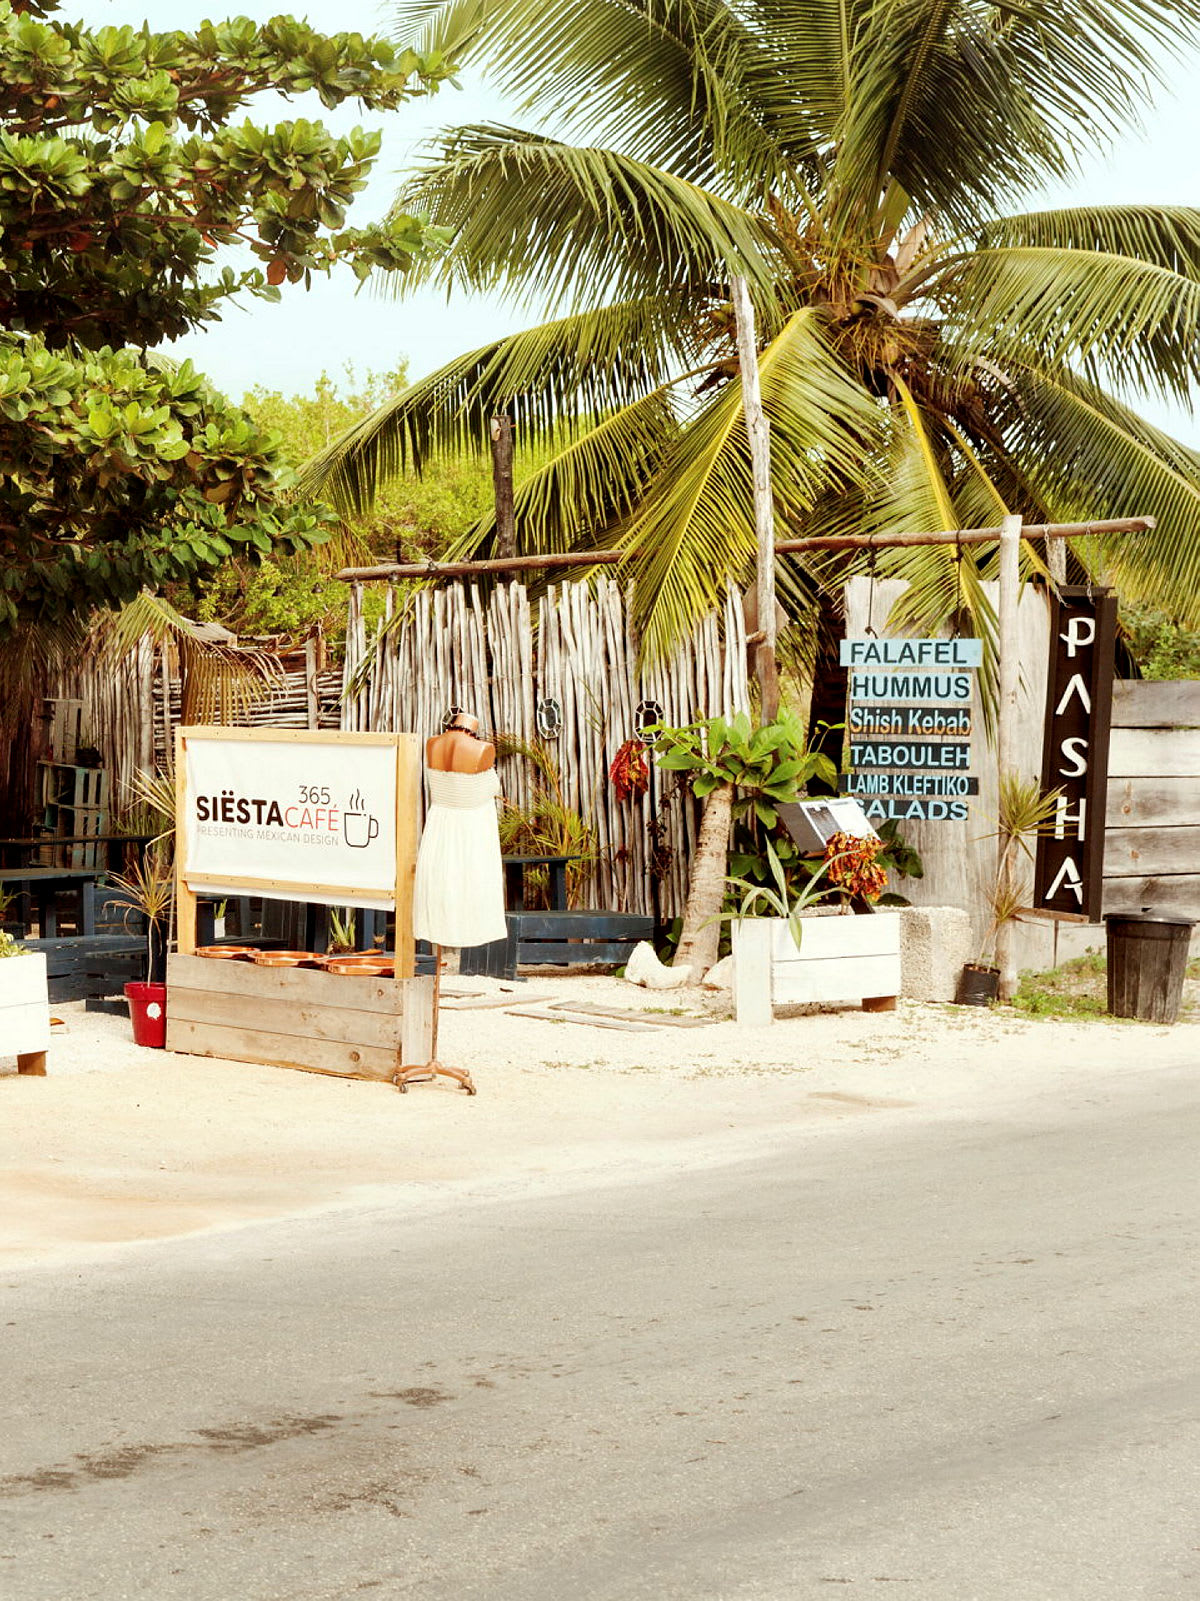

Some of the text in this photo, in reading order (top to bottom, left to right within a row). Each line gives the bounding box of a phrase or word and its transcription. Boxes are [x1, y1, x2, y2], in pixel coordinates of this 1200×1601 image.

[850, 642, 968, 664] FALAFEL
[852, 676, 970, 699] HUMMUS
[850, 707, 973, 736] Shish Kebab
[850, 745, 970, 767] TABOULEH
[1045, 617, 1096, 906] PASHA
[298, 785, 331, 805] 365
[847, 774, 969, 796] LAMB KLEFTIKO
[197, 824, 340, 847] PRESENTING MEXICAN DESIGN
